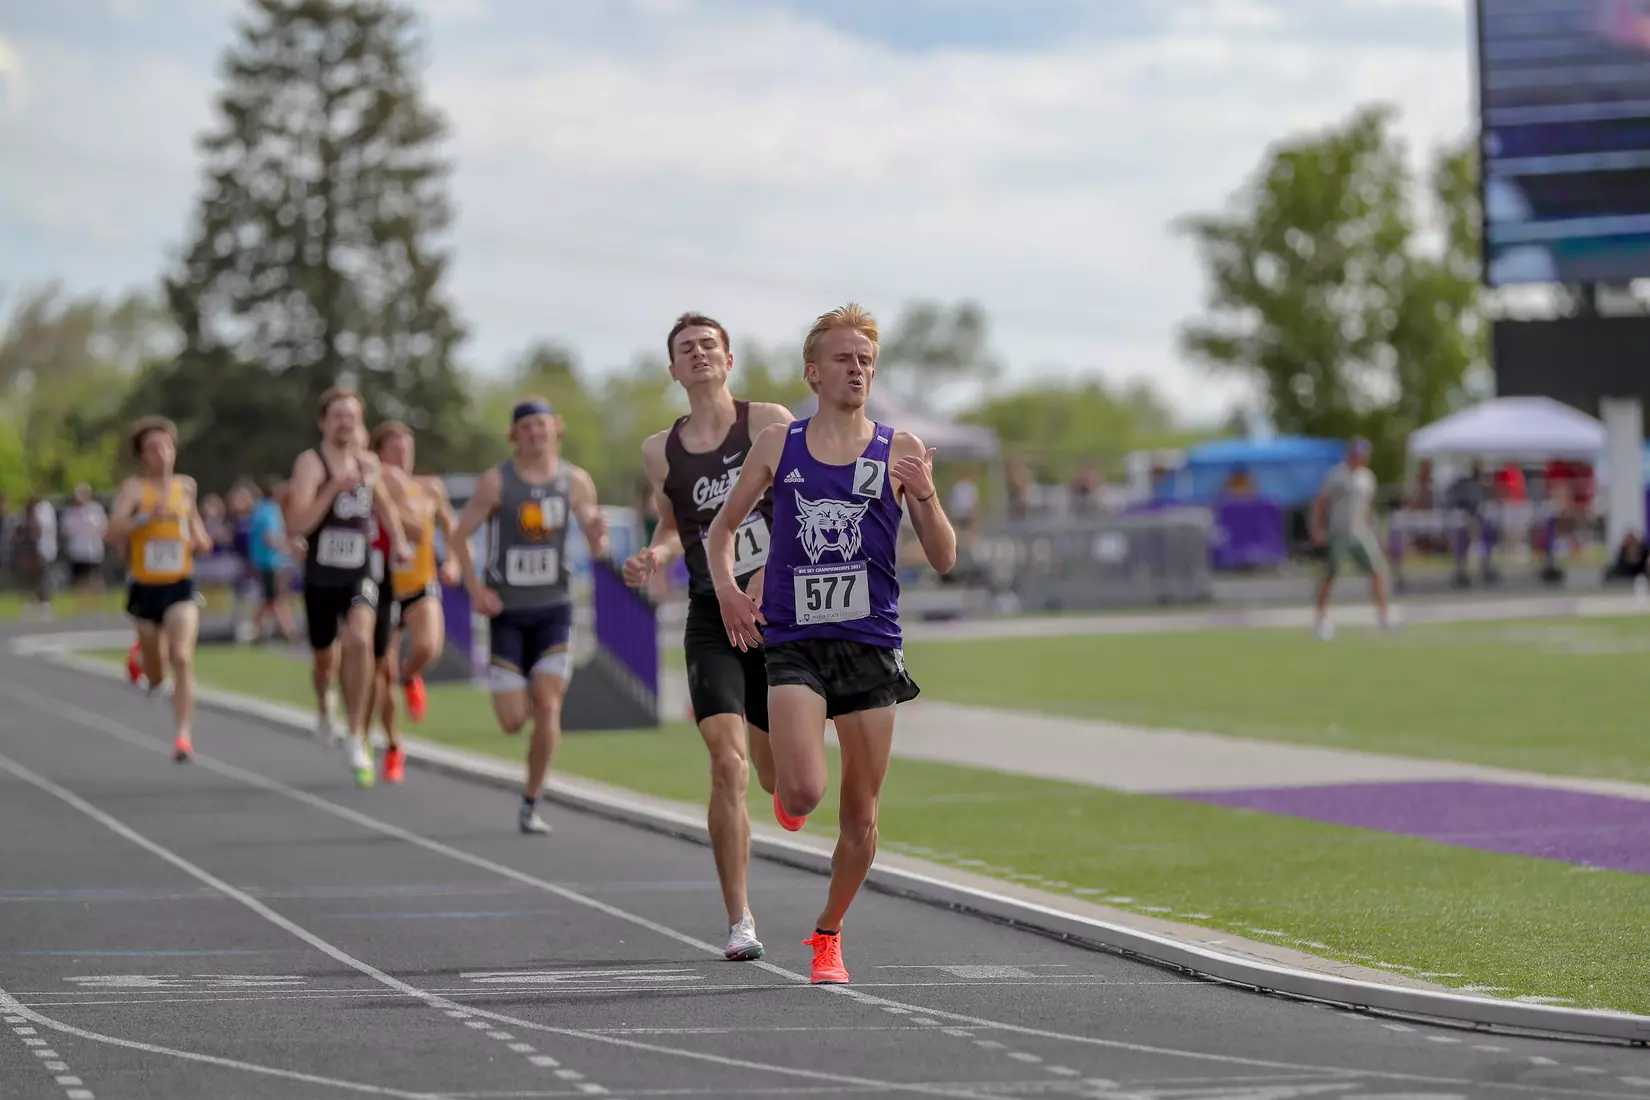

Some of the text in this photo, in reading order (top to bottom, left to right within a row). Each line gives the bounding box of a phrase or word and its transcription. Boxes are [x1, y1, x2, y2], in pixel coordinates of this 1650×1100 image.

[783, 476, 805, 484] adidas
[858, 461, 879, 496] 2
[805, 575, 857, 611] 577
